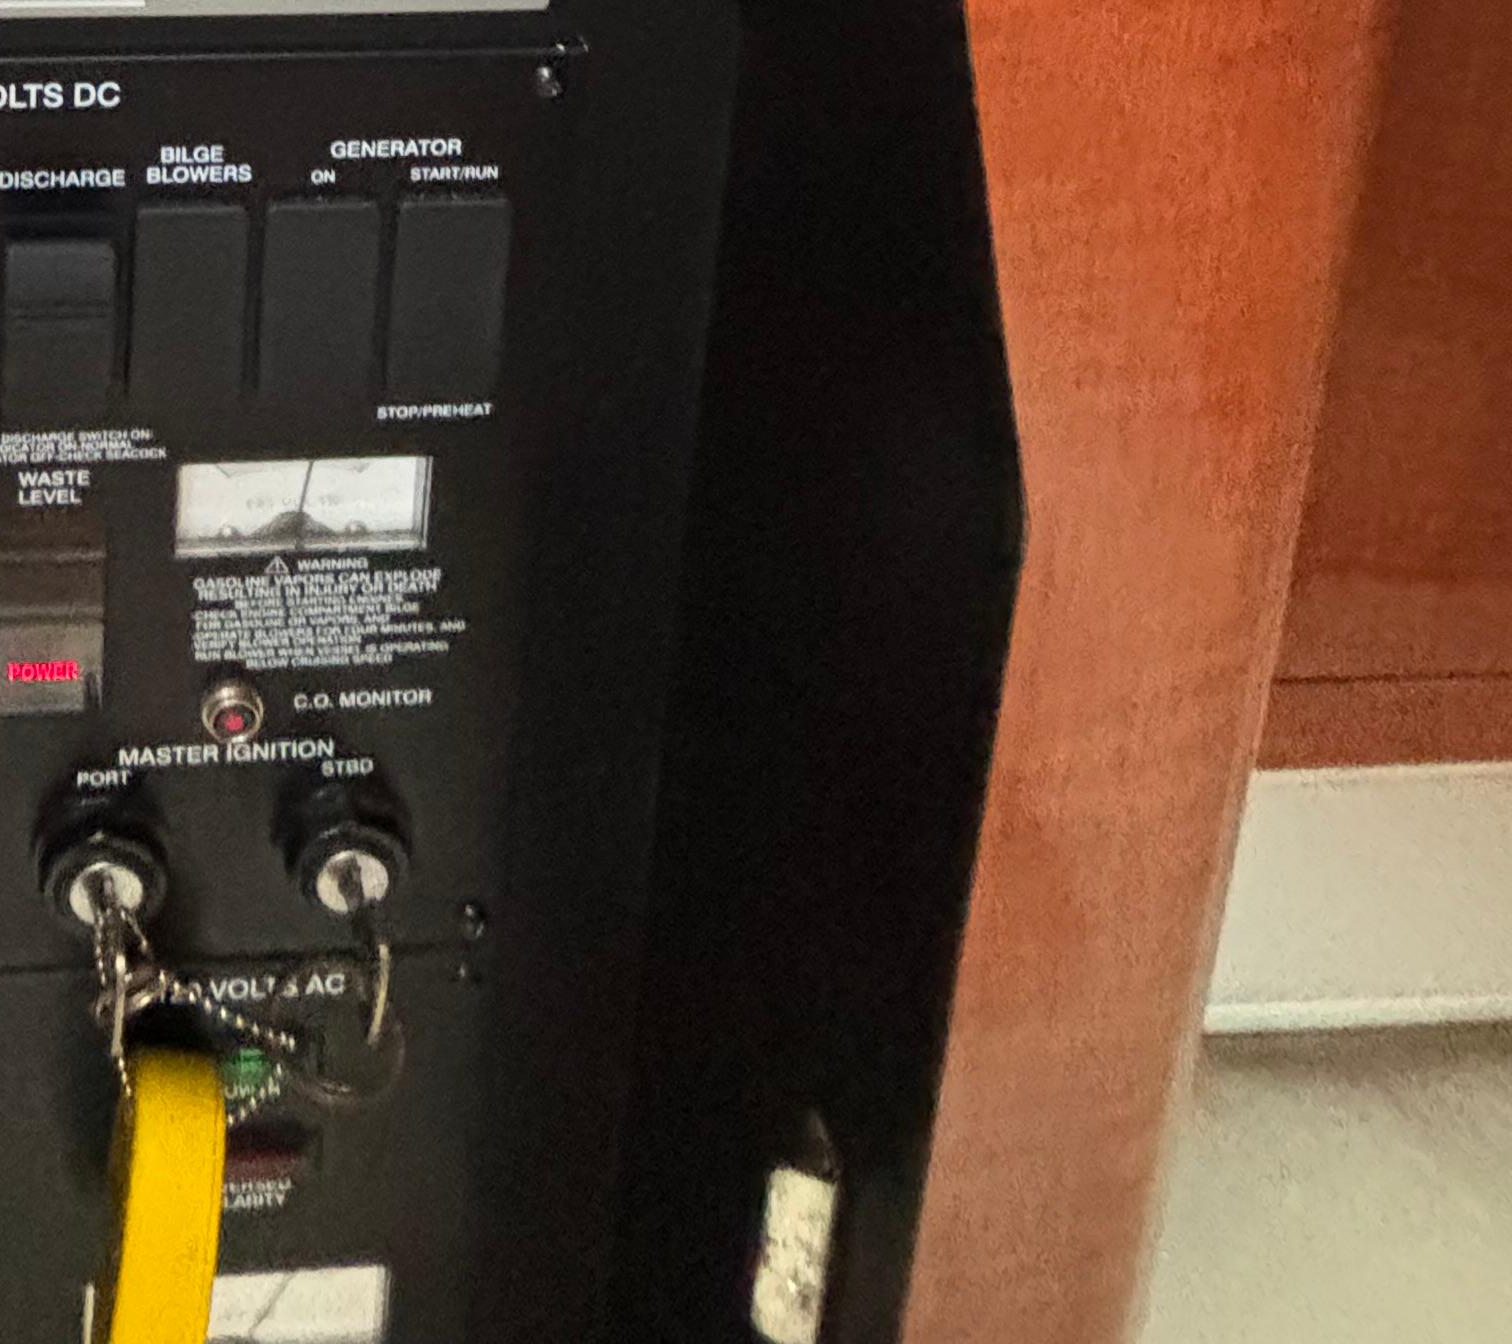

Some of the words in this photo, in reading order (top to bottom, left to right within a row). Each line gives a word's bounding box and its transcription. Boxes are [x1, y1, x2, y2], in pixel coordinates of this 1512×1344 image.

[73, 82, 121, 108] DC
[160, 144, 224, 165] BILGE
[330, 138, 462, 160] GENERATOR
[146, 163, 253, 185] BLOWERS
[311, 168, 336, 185] ON
[410, 165, 499, 183] START/RUN
[377, 401, 493, 421] STOP/PREHEAT
[17, 469, 90, 488] WASTE
[18, 487, 82, 506] LEVEL
[298, 556, 368, 571] WARNING
[7, 660, 80, 682] POWER
[294, 692, 333, 711] C.O.
[338, 688, 432, 709] MONITOR
[119, 743, 219, 767] MASTER
[226, 739, 335, 763] IGNITION
[77, 769, 131, 788] PORT
[321, 757, 375, 778] STBD
[305, 974, 345, 996] AC
